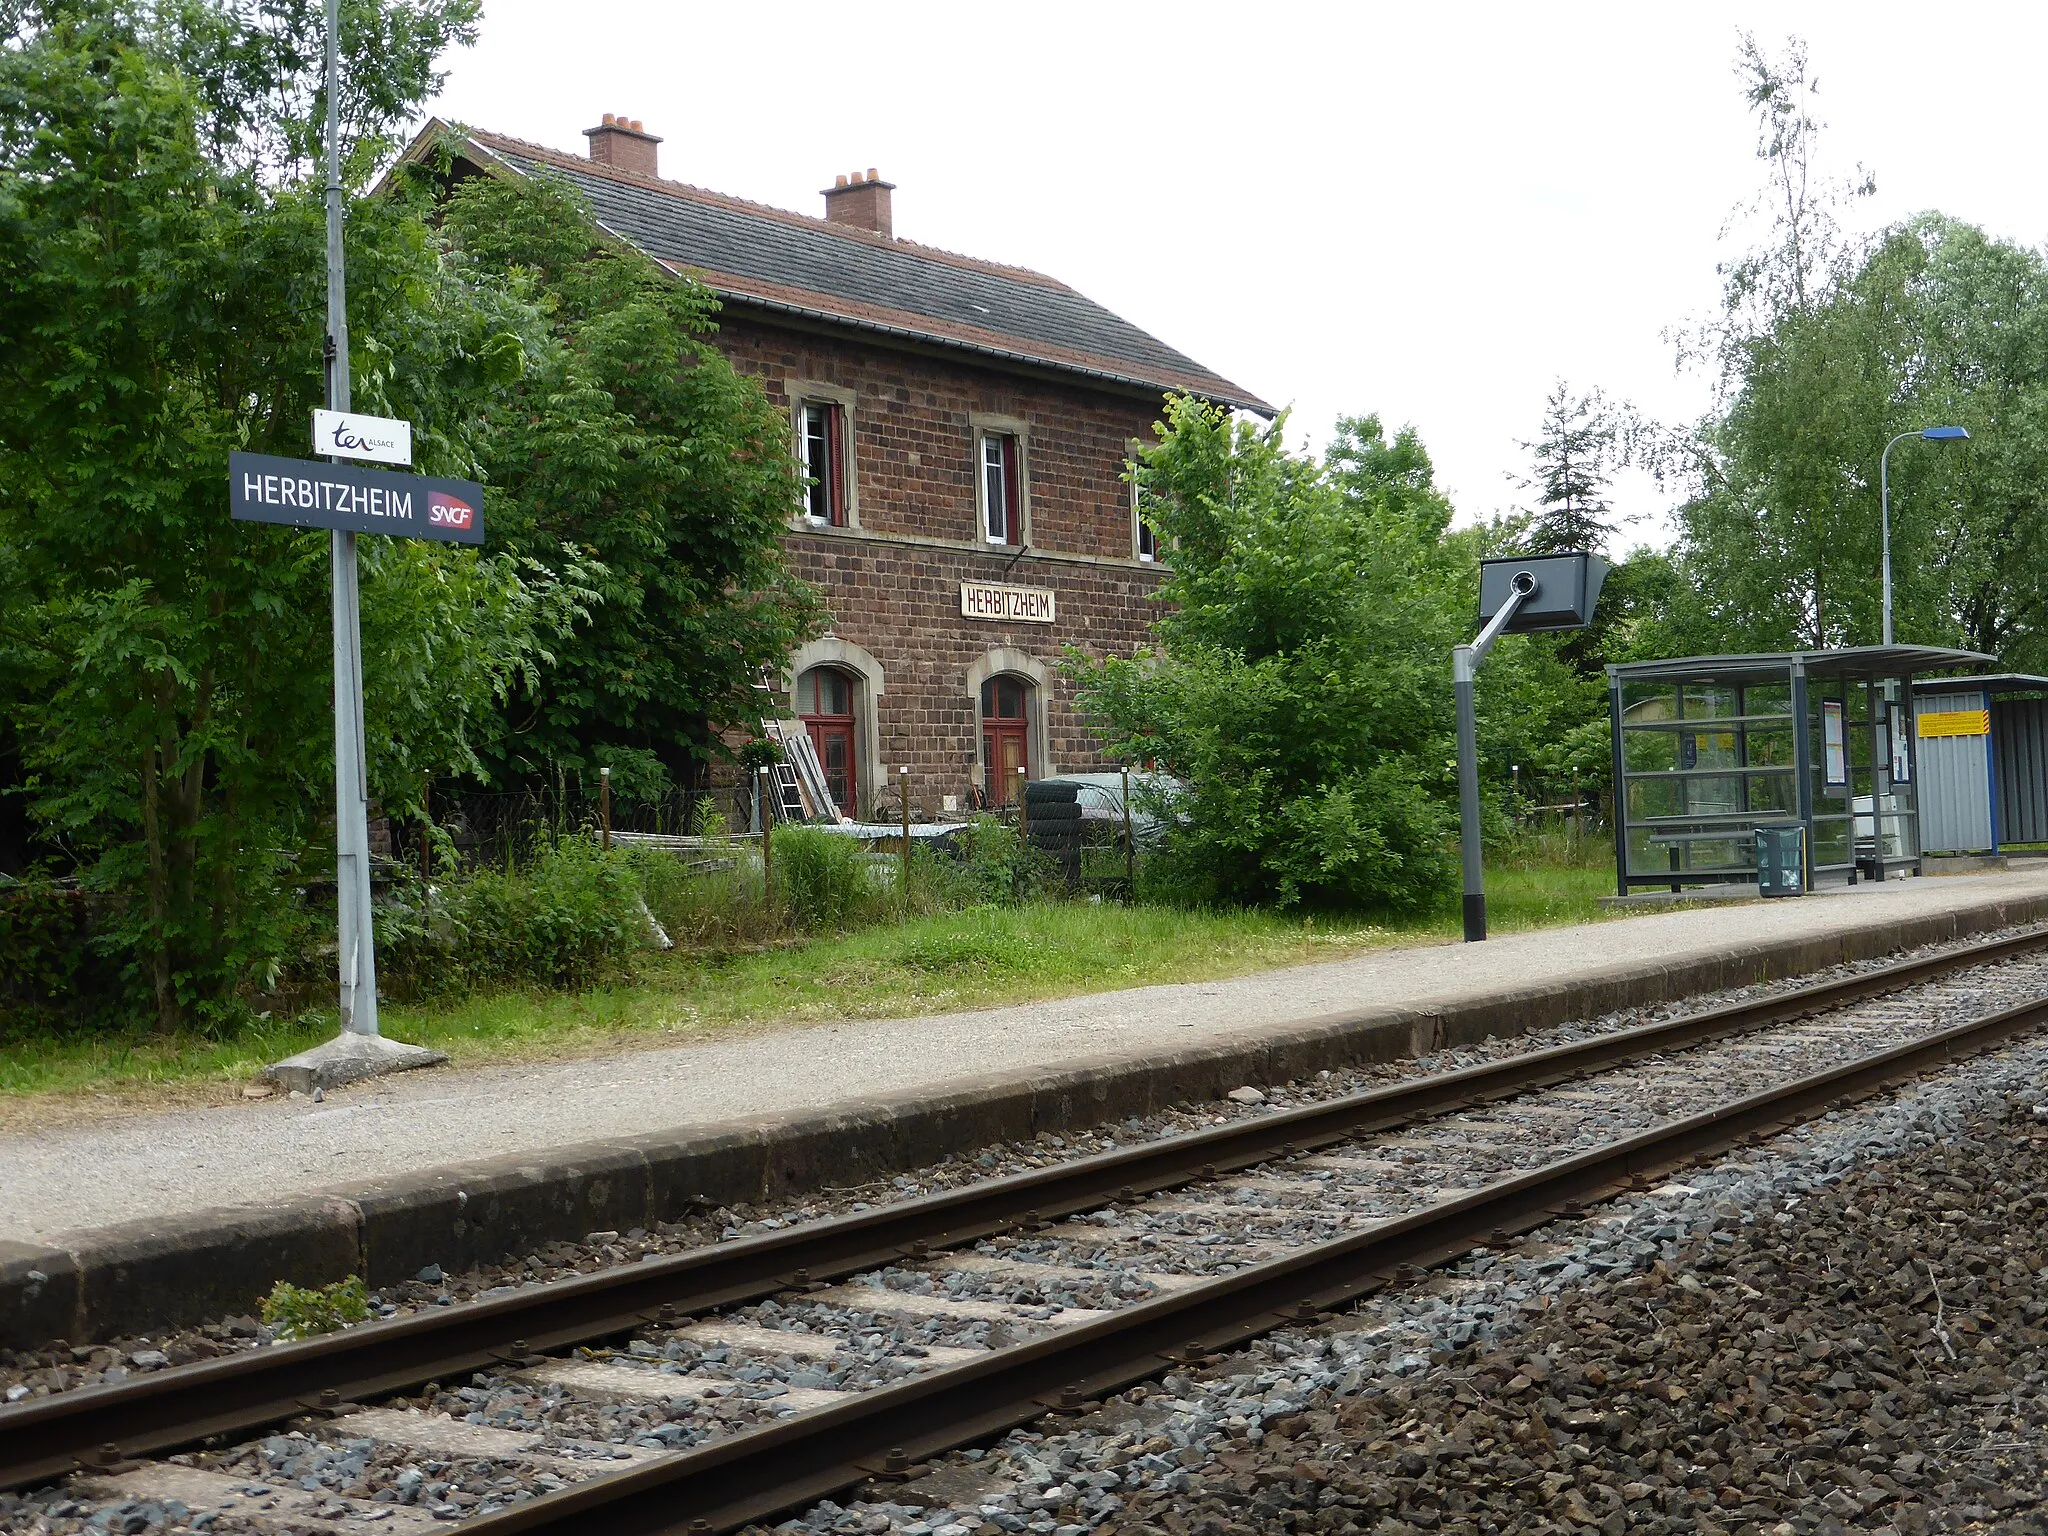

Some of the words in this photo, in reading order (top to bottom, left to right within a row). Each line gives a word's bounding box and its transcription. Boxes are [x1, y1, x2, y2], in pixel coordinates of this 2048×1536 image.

[332, 420, 374, 452] ter
[368, 439, 395, 449] ALSACE
[243, 472, 413, 519] HERBITZHEIM
[430, 505, 471, 525] SNCF
[967, 587, 1050, 618] HERBITZHEIM
